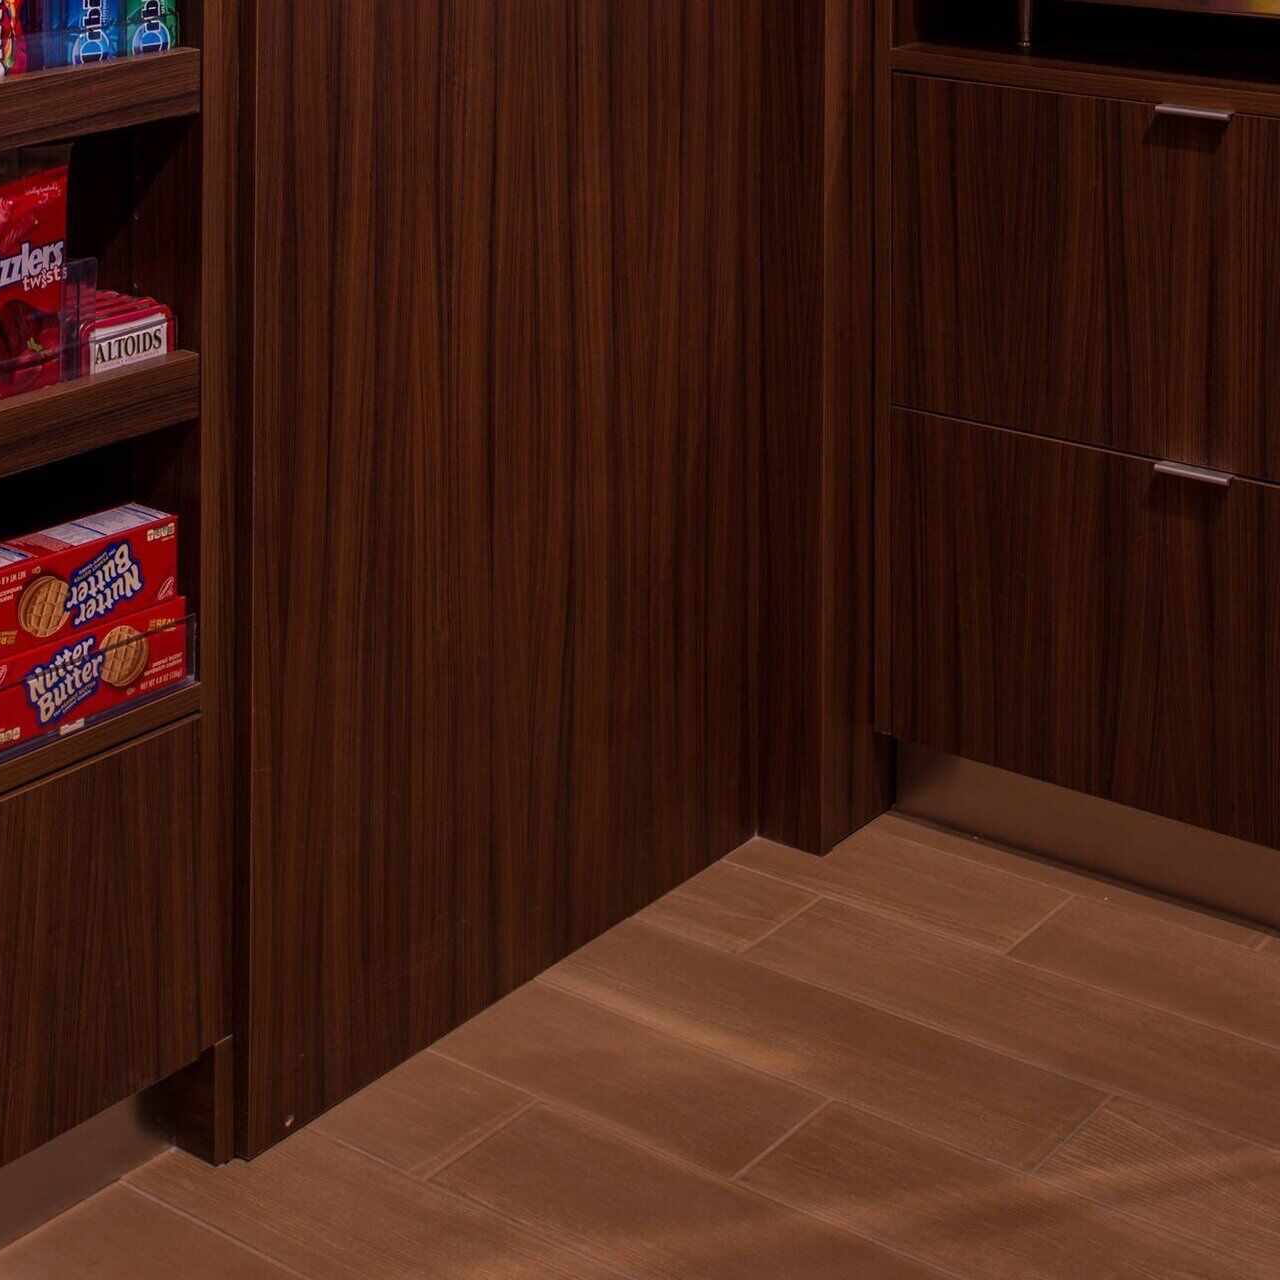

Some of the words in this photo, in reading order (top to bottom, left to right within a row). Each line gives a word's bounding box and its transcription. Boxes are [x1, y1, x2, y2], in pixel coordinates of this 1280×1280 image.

[22, 265, 68, 293] twists
[93, 328, 162, 366] ALTOIDS
[65, 542, 134, 607] Butter
[75, 570, 142, 626] Nutter
[28, 636, 95, 704] Nutter
[37, 651, 104, 725] Butter
